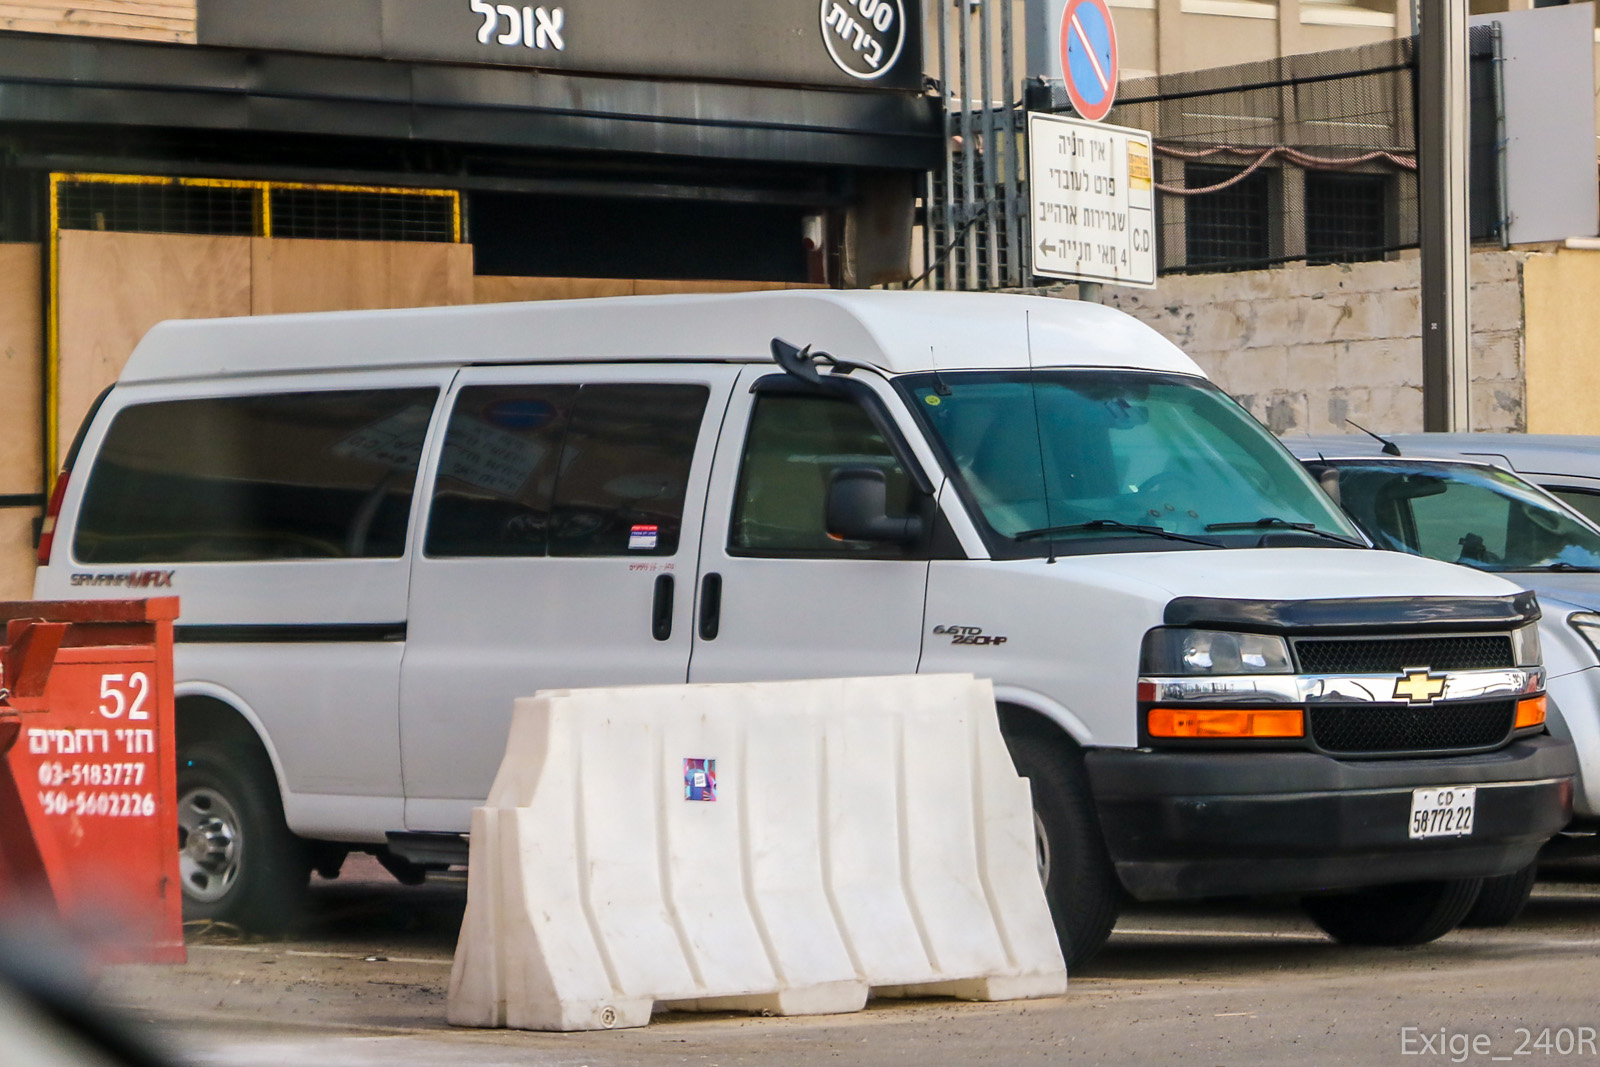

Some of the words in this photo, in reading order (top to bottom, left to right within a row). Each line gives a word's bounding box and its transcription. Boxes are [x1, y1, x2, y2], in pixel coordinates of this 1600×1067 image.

[470, 0, 564, 50] אוכל
[848, 0, 893, 32] 00
[826, 3, 883, 68] בירות
[1058, 134, 1084, 157] חניה
[1090, 140, 1105, 162] אין
[1050, 168, 1089, 192] לעובדי
[1094, 174, 1115, 196] פרט
[1083, 208, 1126, 231] שגרירות
[1059, 239, 1091, 261] חנייה
[1097, 244, 1116, 265] תאי
[1121, 248, 1127, 266] 4
[933, 624, 982, 635] 6.6TD
[951, 635, 1007, 645] 260HP
[99, 672, 149, 720] 52
[28, 728, 108, 754] רחמים
[115, 729, 154, 753] חזי
[38, 761, 145, 786] 03-5183777
